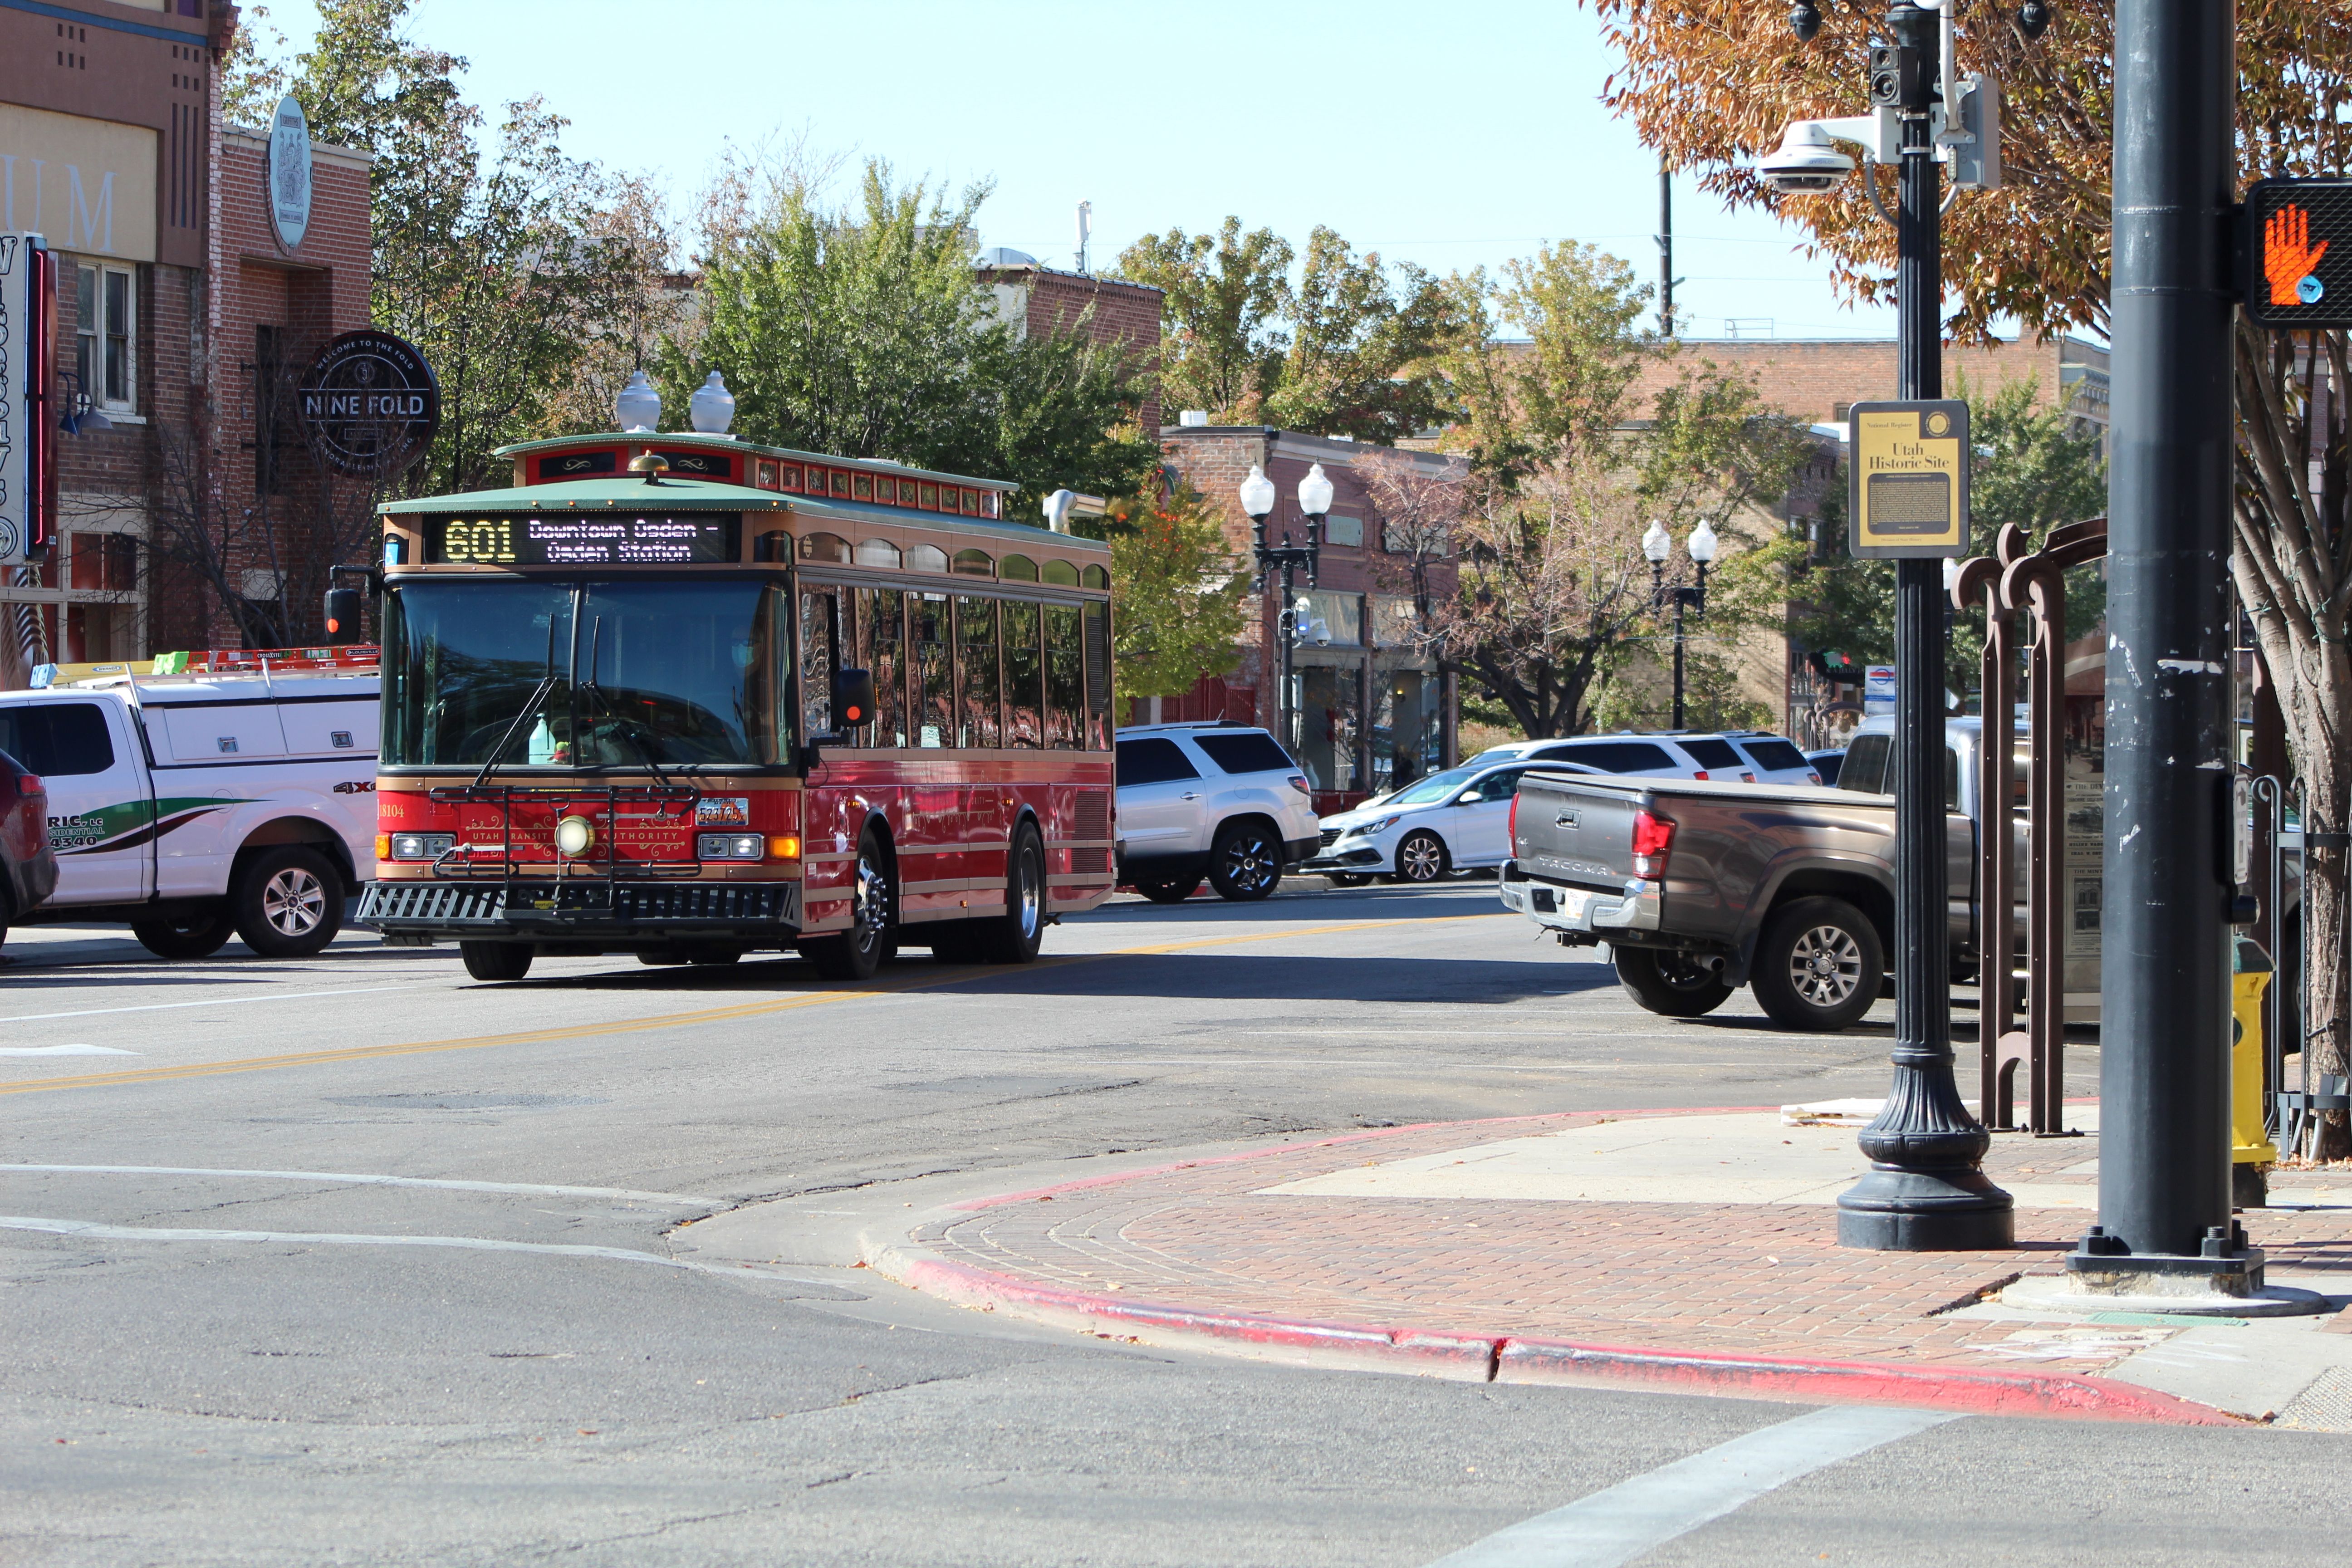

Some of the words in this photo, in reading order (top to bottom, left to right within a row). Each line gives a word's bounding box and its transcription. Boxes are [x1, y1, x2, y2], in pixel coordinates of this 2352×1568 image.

[316, 341, 356, 370] WELCOME
[376, 342, 392, 352] THE
[395, 350, 414, 370] FOLD
[306, 396, 360, 415] NINE
[368, 396, 423, 415] FOLD
[1892, 442, 1924, 456] Utah
[1869, 456, 1922, 470] Historic
[1924, 455, 1950, 469] Site
[445, 520, 516, 563] 601
[529, 519, 626, 539] Downtown
[634, 519, 697, 538] Ogden
[547, 542, 609, 563] Ogden
[619, 541, 691, 563] Station
[380, 804, 404, 818] 18104
[50, 835, 98, 848] 4340
[1539, 856, 1607, 876] TACOMA
